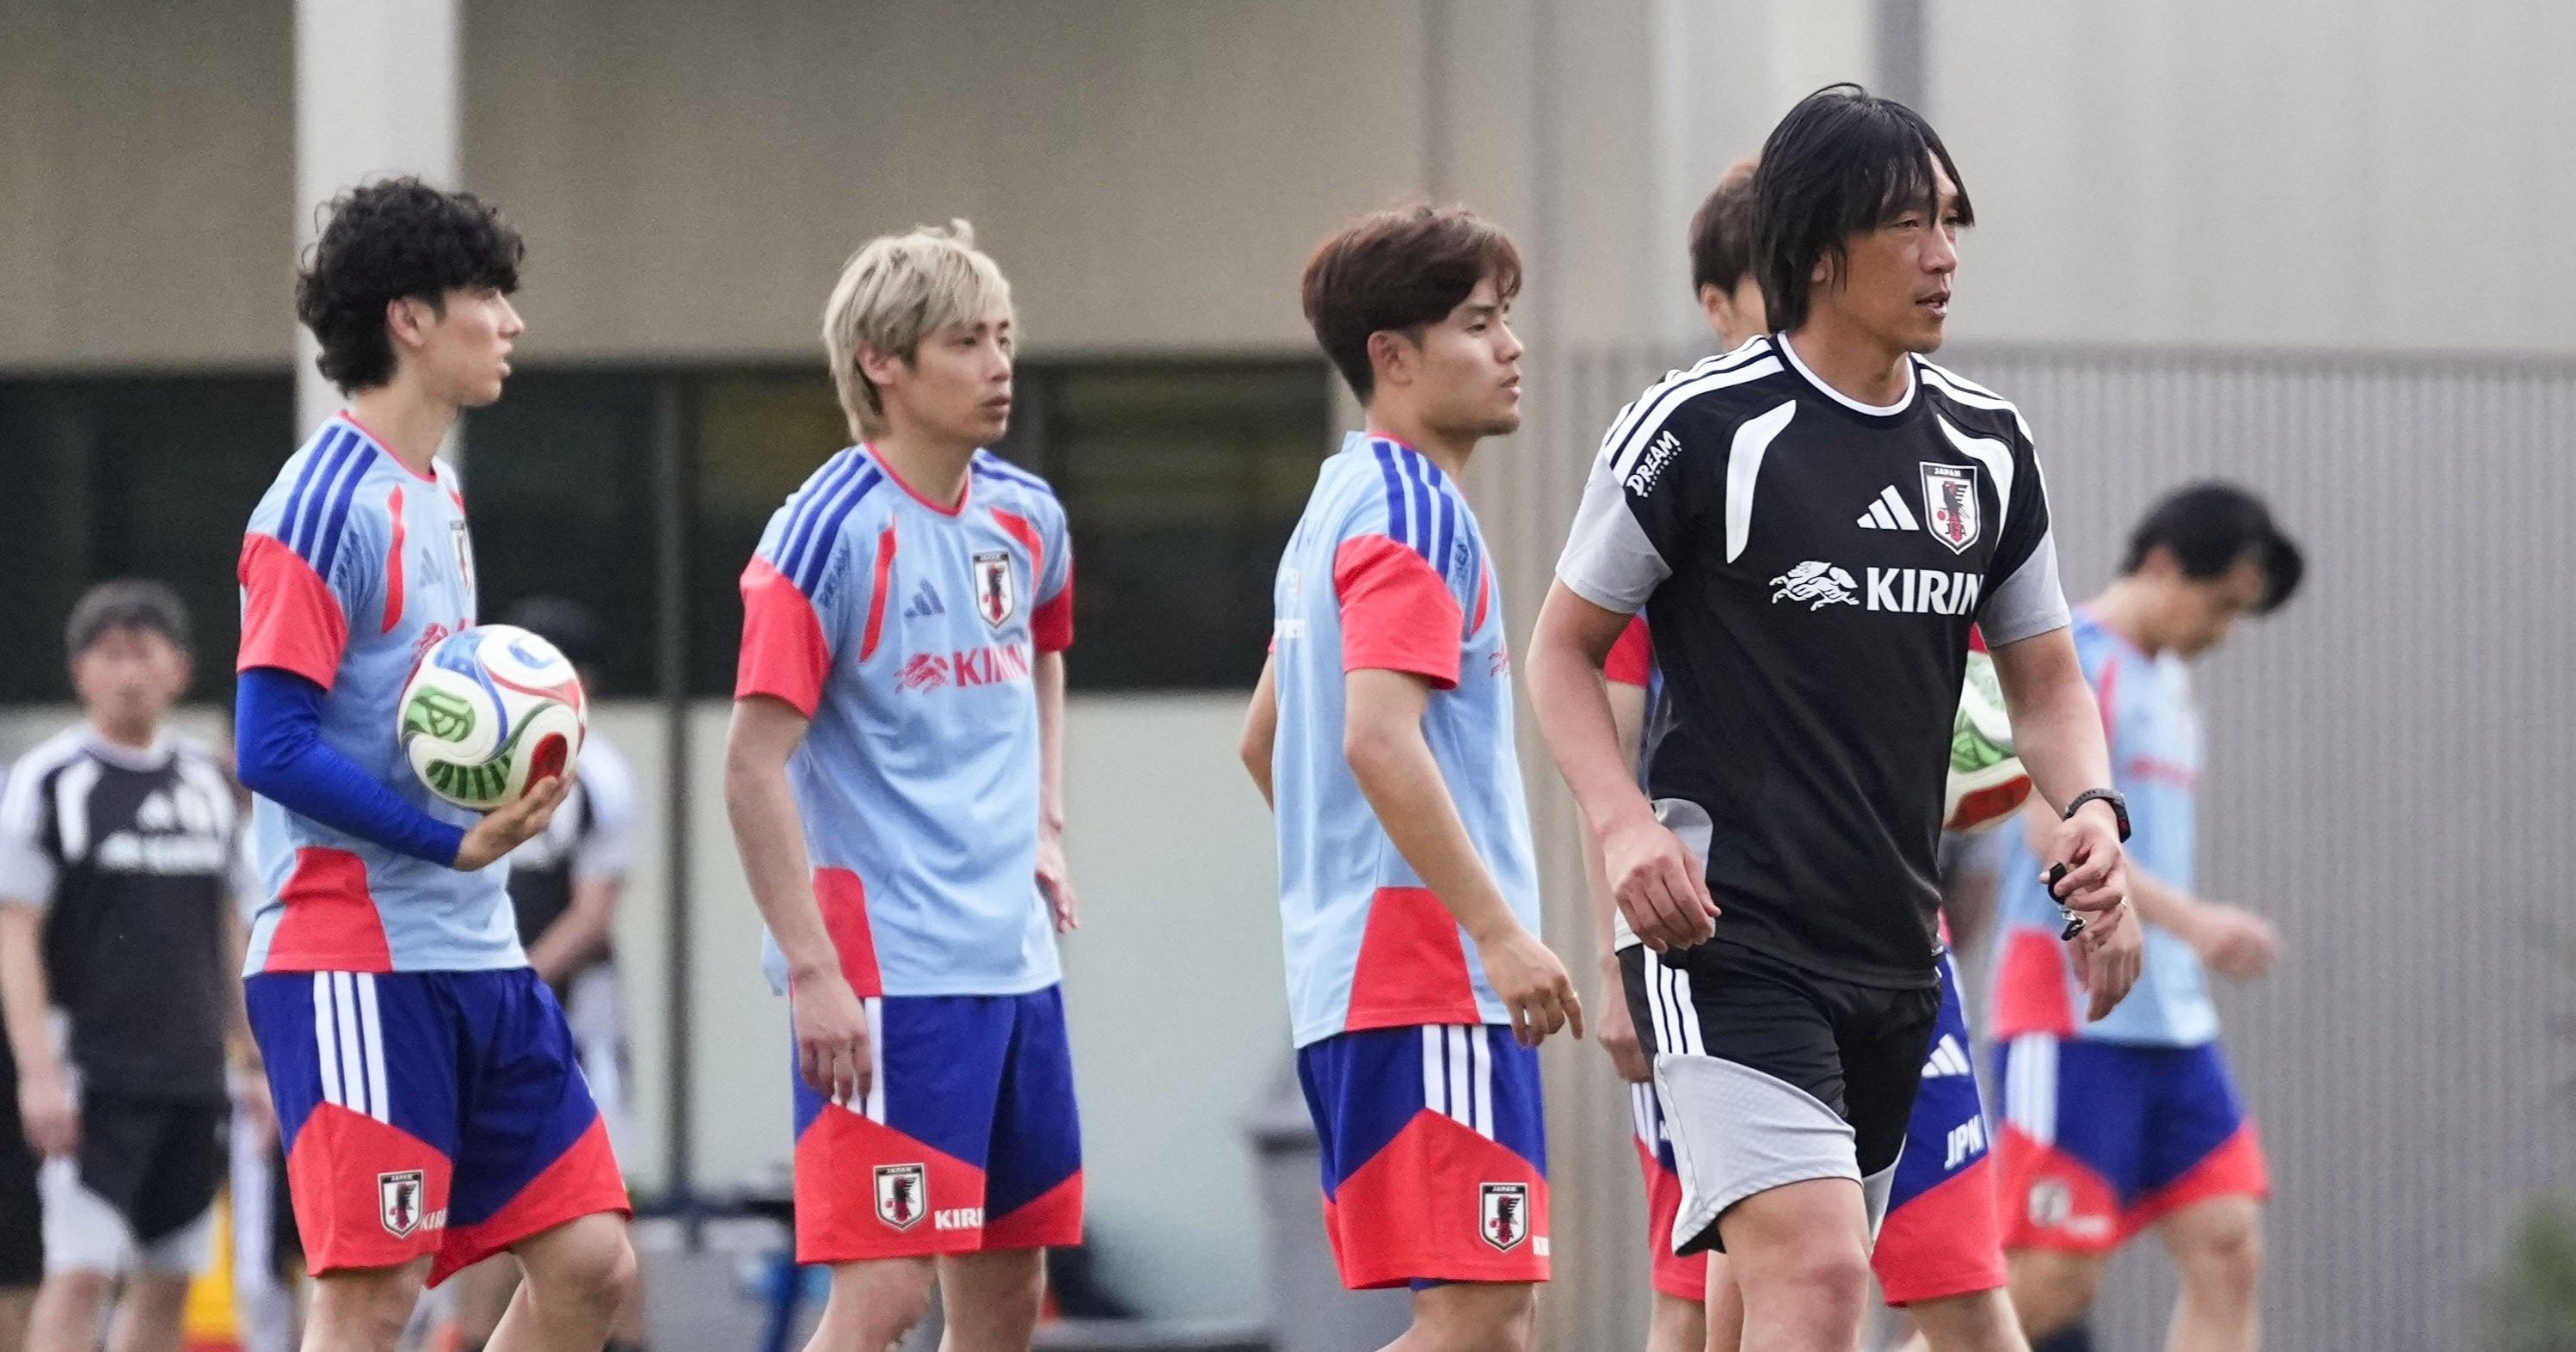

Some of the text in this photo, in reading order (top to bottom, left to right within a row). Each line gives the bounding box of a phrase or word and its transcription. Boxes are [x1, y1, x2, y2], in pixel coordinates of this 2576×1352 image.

[1626, 430, 1681, 496] DREAM
[1866, 567, 1984, 615] KIRIN
[1945, 1113, 1983, 1171] JPN
